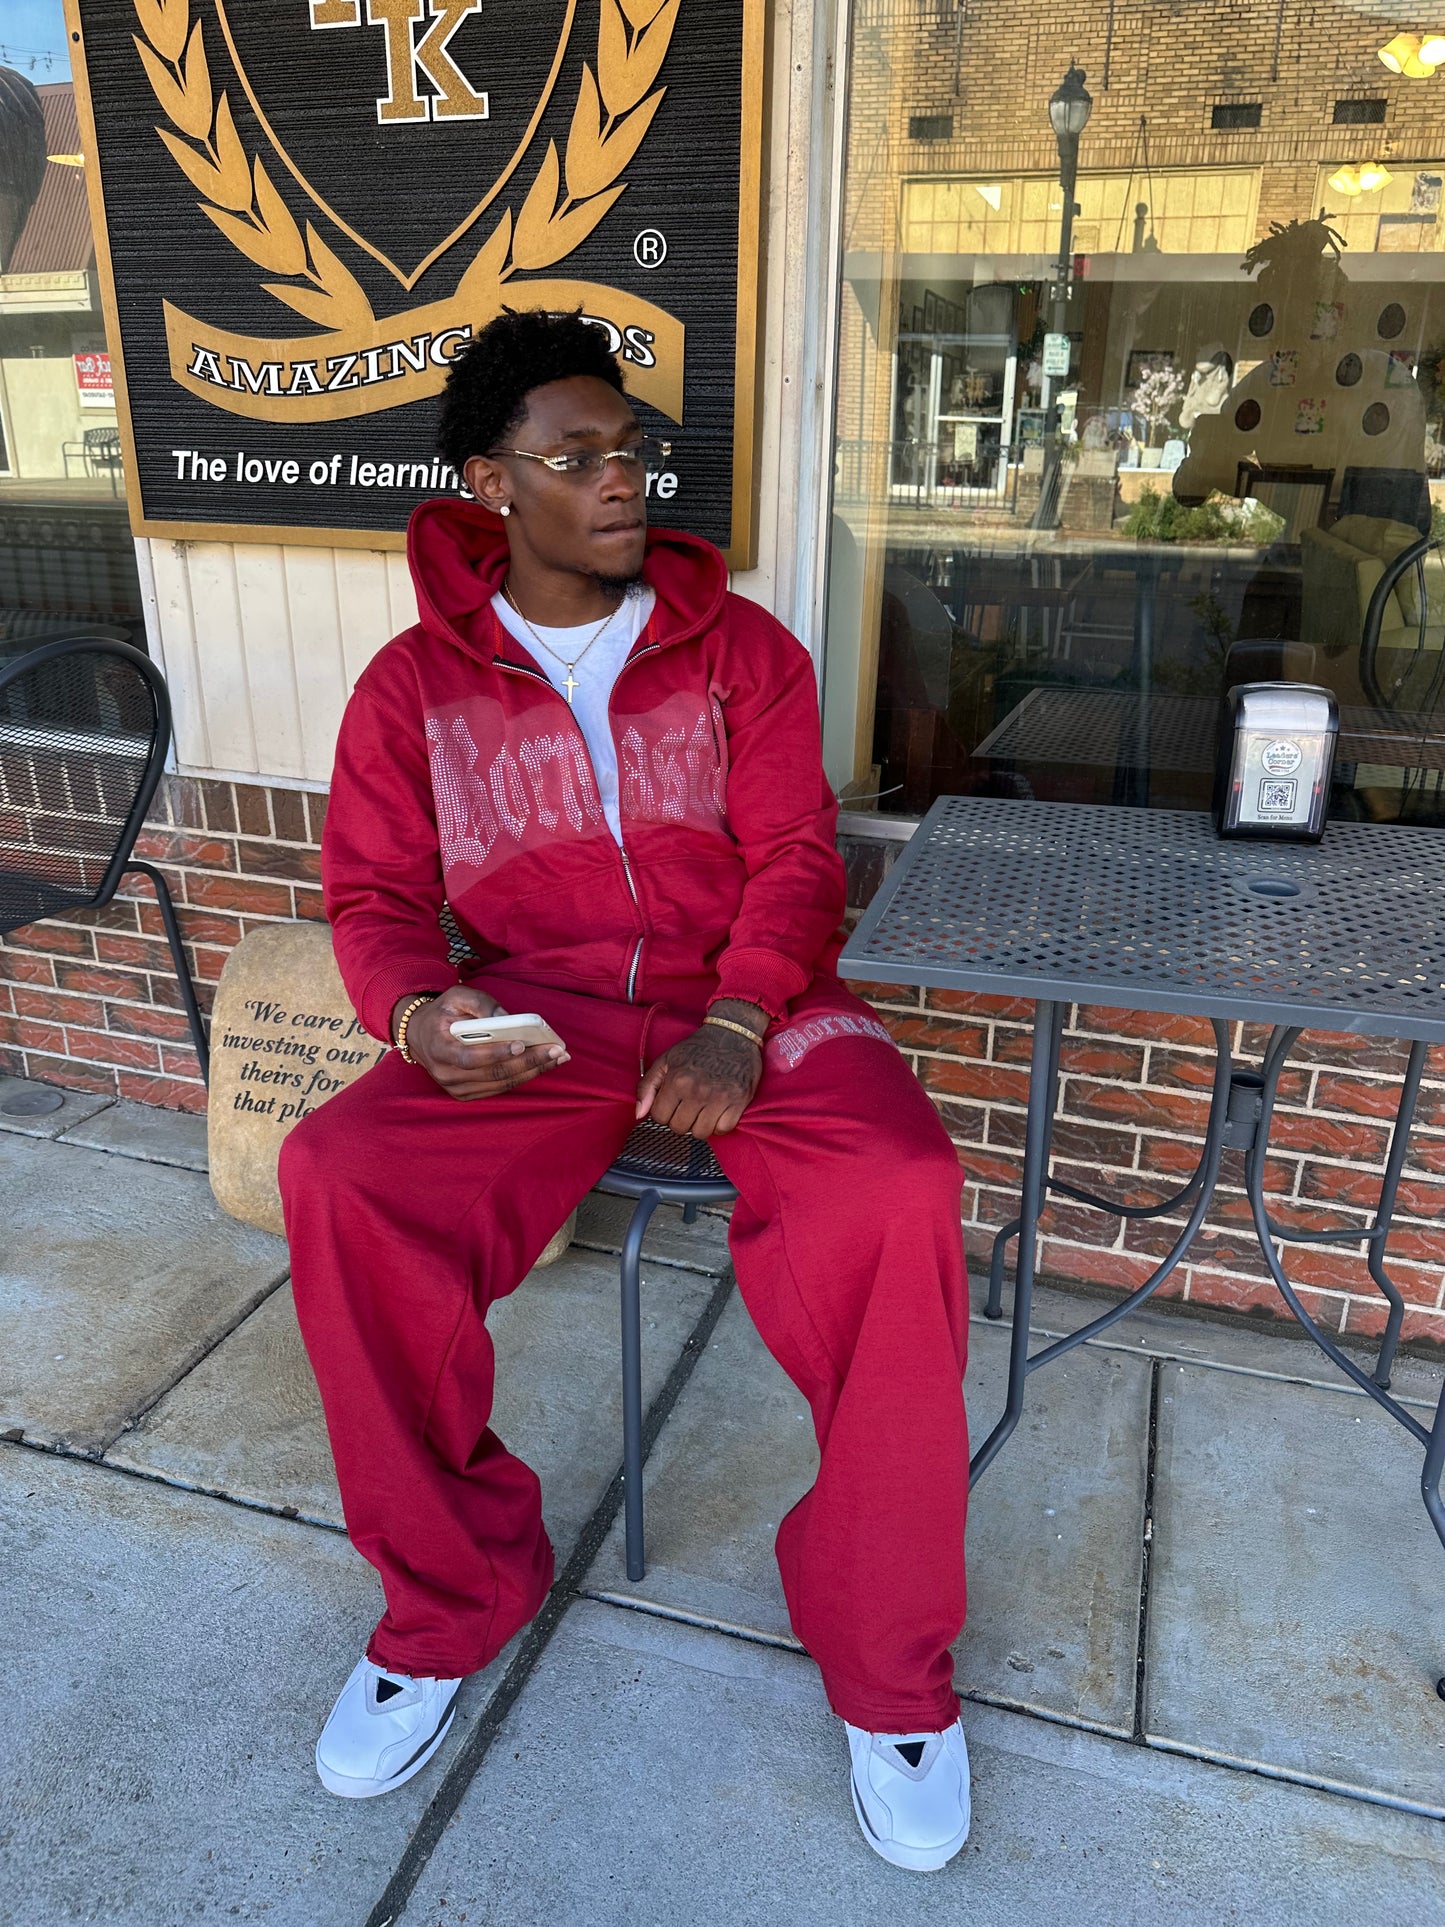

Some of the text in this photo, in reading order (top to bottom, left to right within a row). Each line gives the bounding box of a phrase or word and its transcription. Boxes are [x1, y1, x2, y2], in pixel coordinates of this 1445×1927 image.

[187, 325, 473, 397] AMAZING
[172, 450, 227, 481] The
[236, 452, 300, 484] love
[308, 454, 342, 486] of
[291, 1011, 343, 1031] care
[339, 1016, 368, 1039] fo
[222, 1028, 321, 1065] investing
[326, 1047, 370, 1065] our
[240, 1060, 345, 1096] theirs for
[232, 1091, 276, 1114] that
